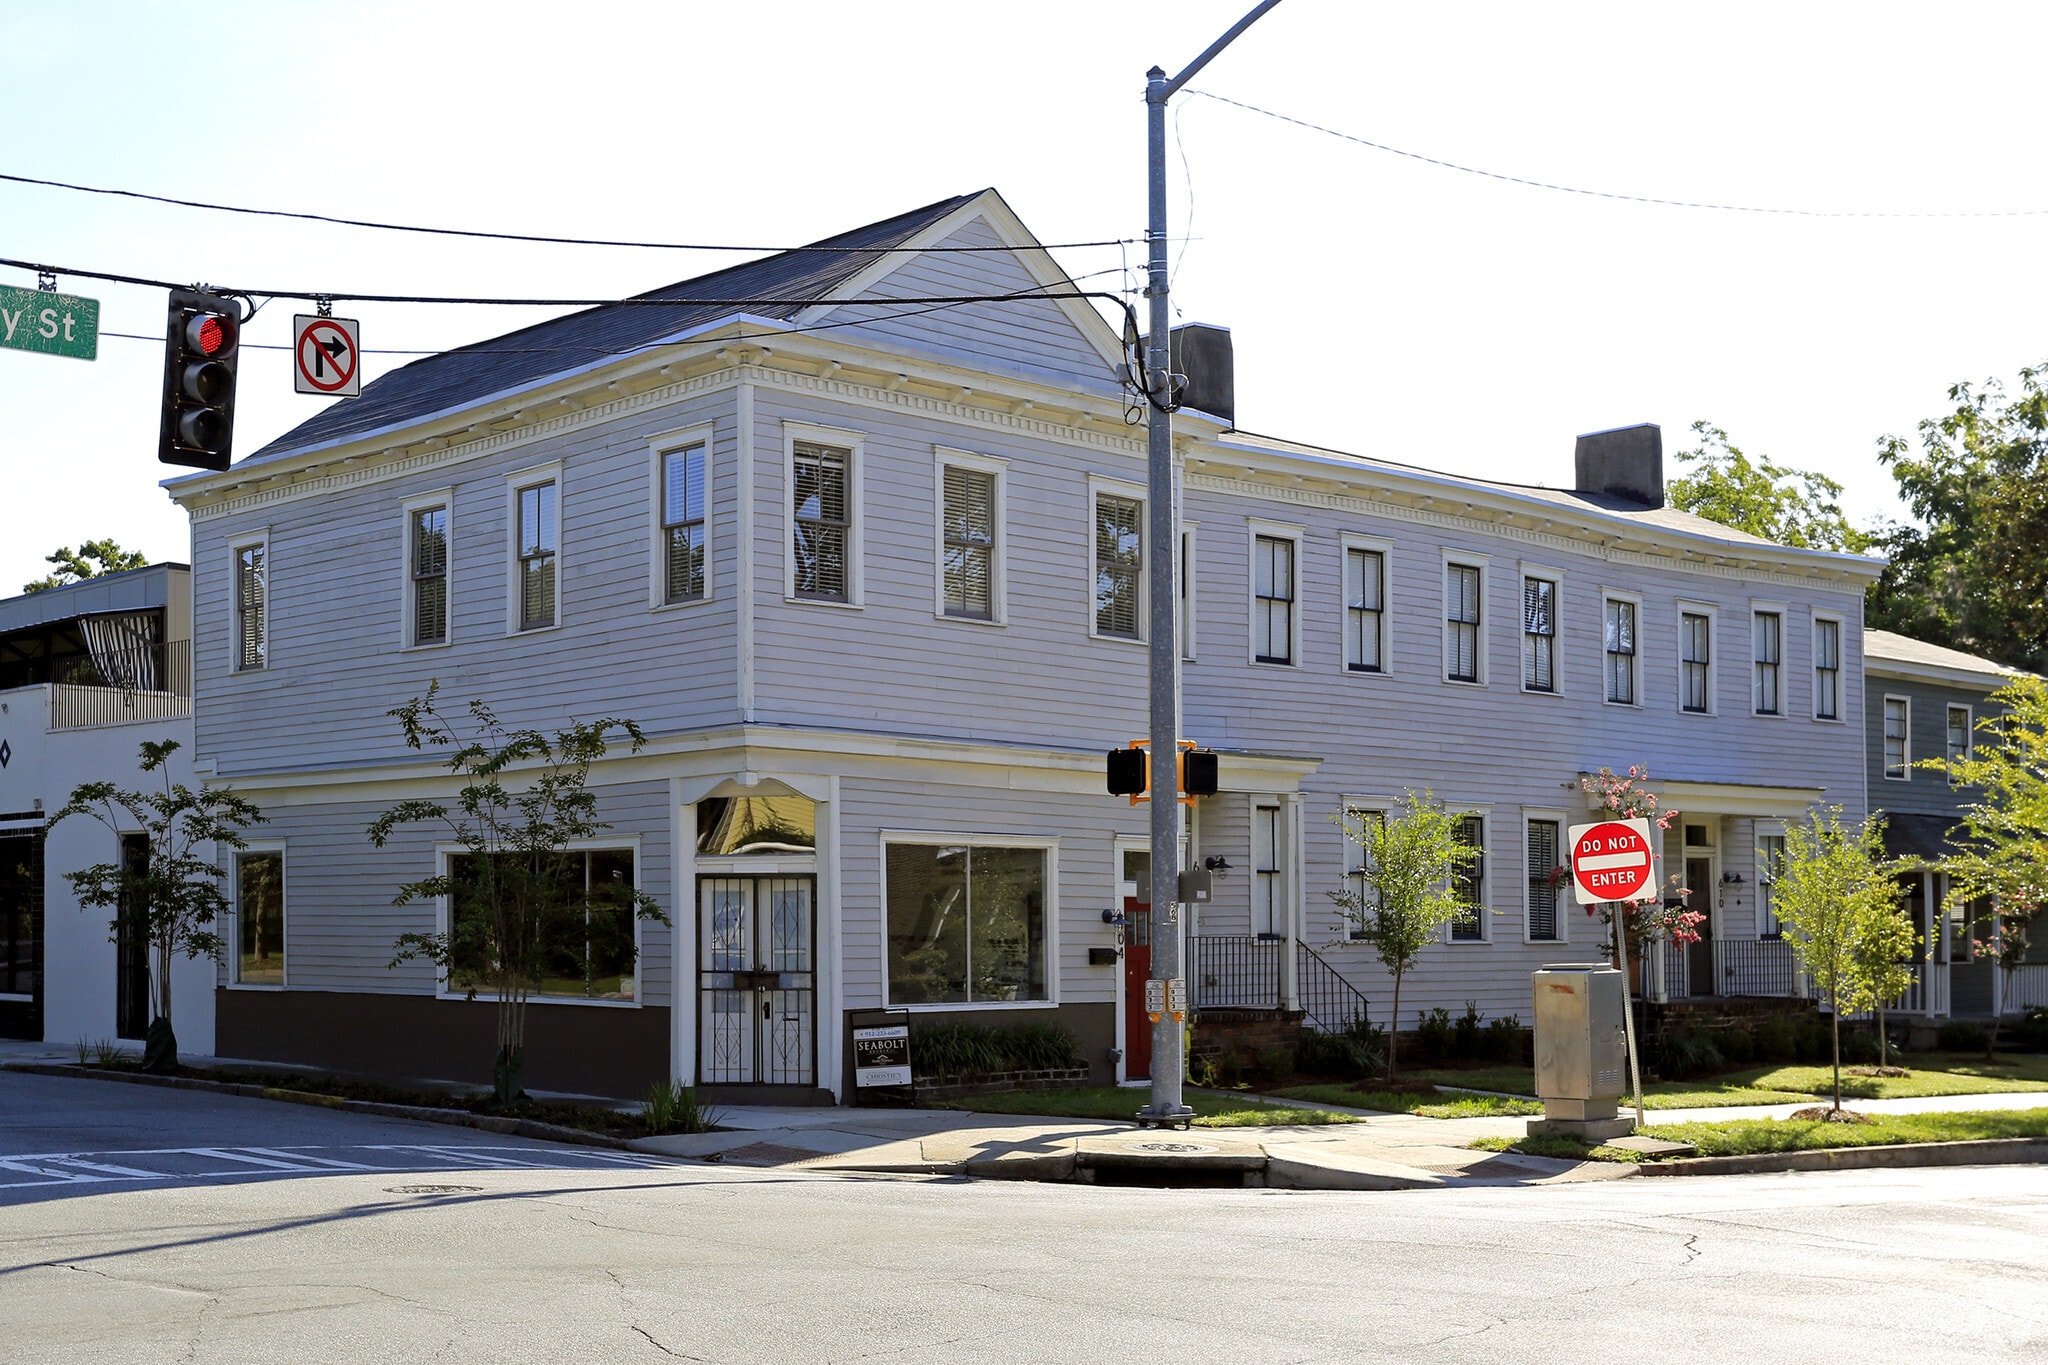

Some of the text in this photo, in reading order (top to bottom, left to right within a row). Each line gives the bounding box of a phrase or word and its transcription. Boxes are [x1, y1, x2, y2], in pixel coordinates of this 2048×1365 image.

[39, 308, 76, 342] St
[1582, 835, 1637, 853] DO NOT
[1591, 871, 1636, 887] ENTER
[858, 1039, 905, 1051] SEABOLT
